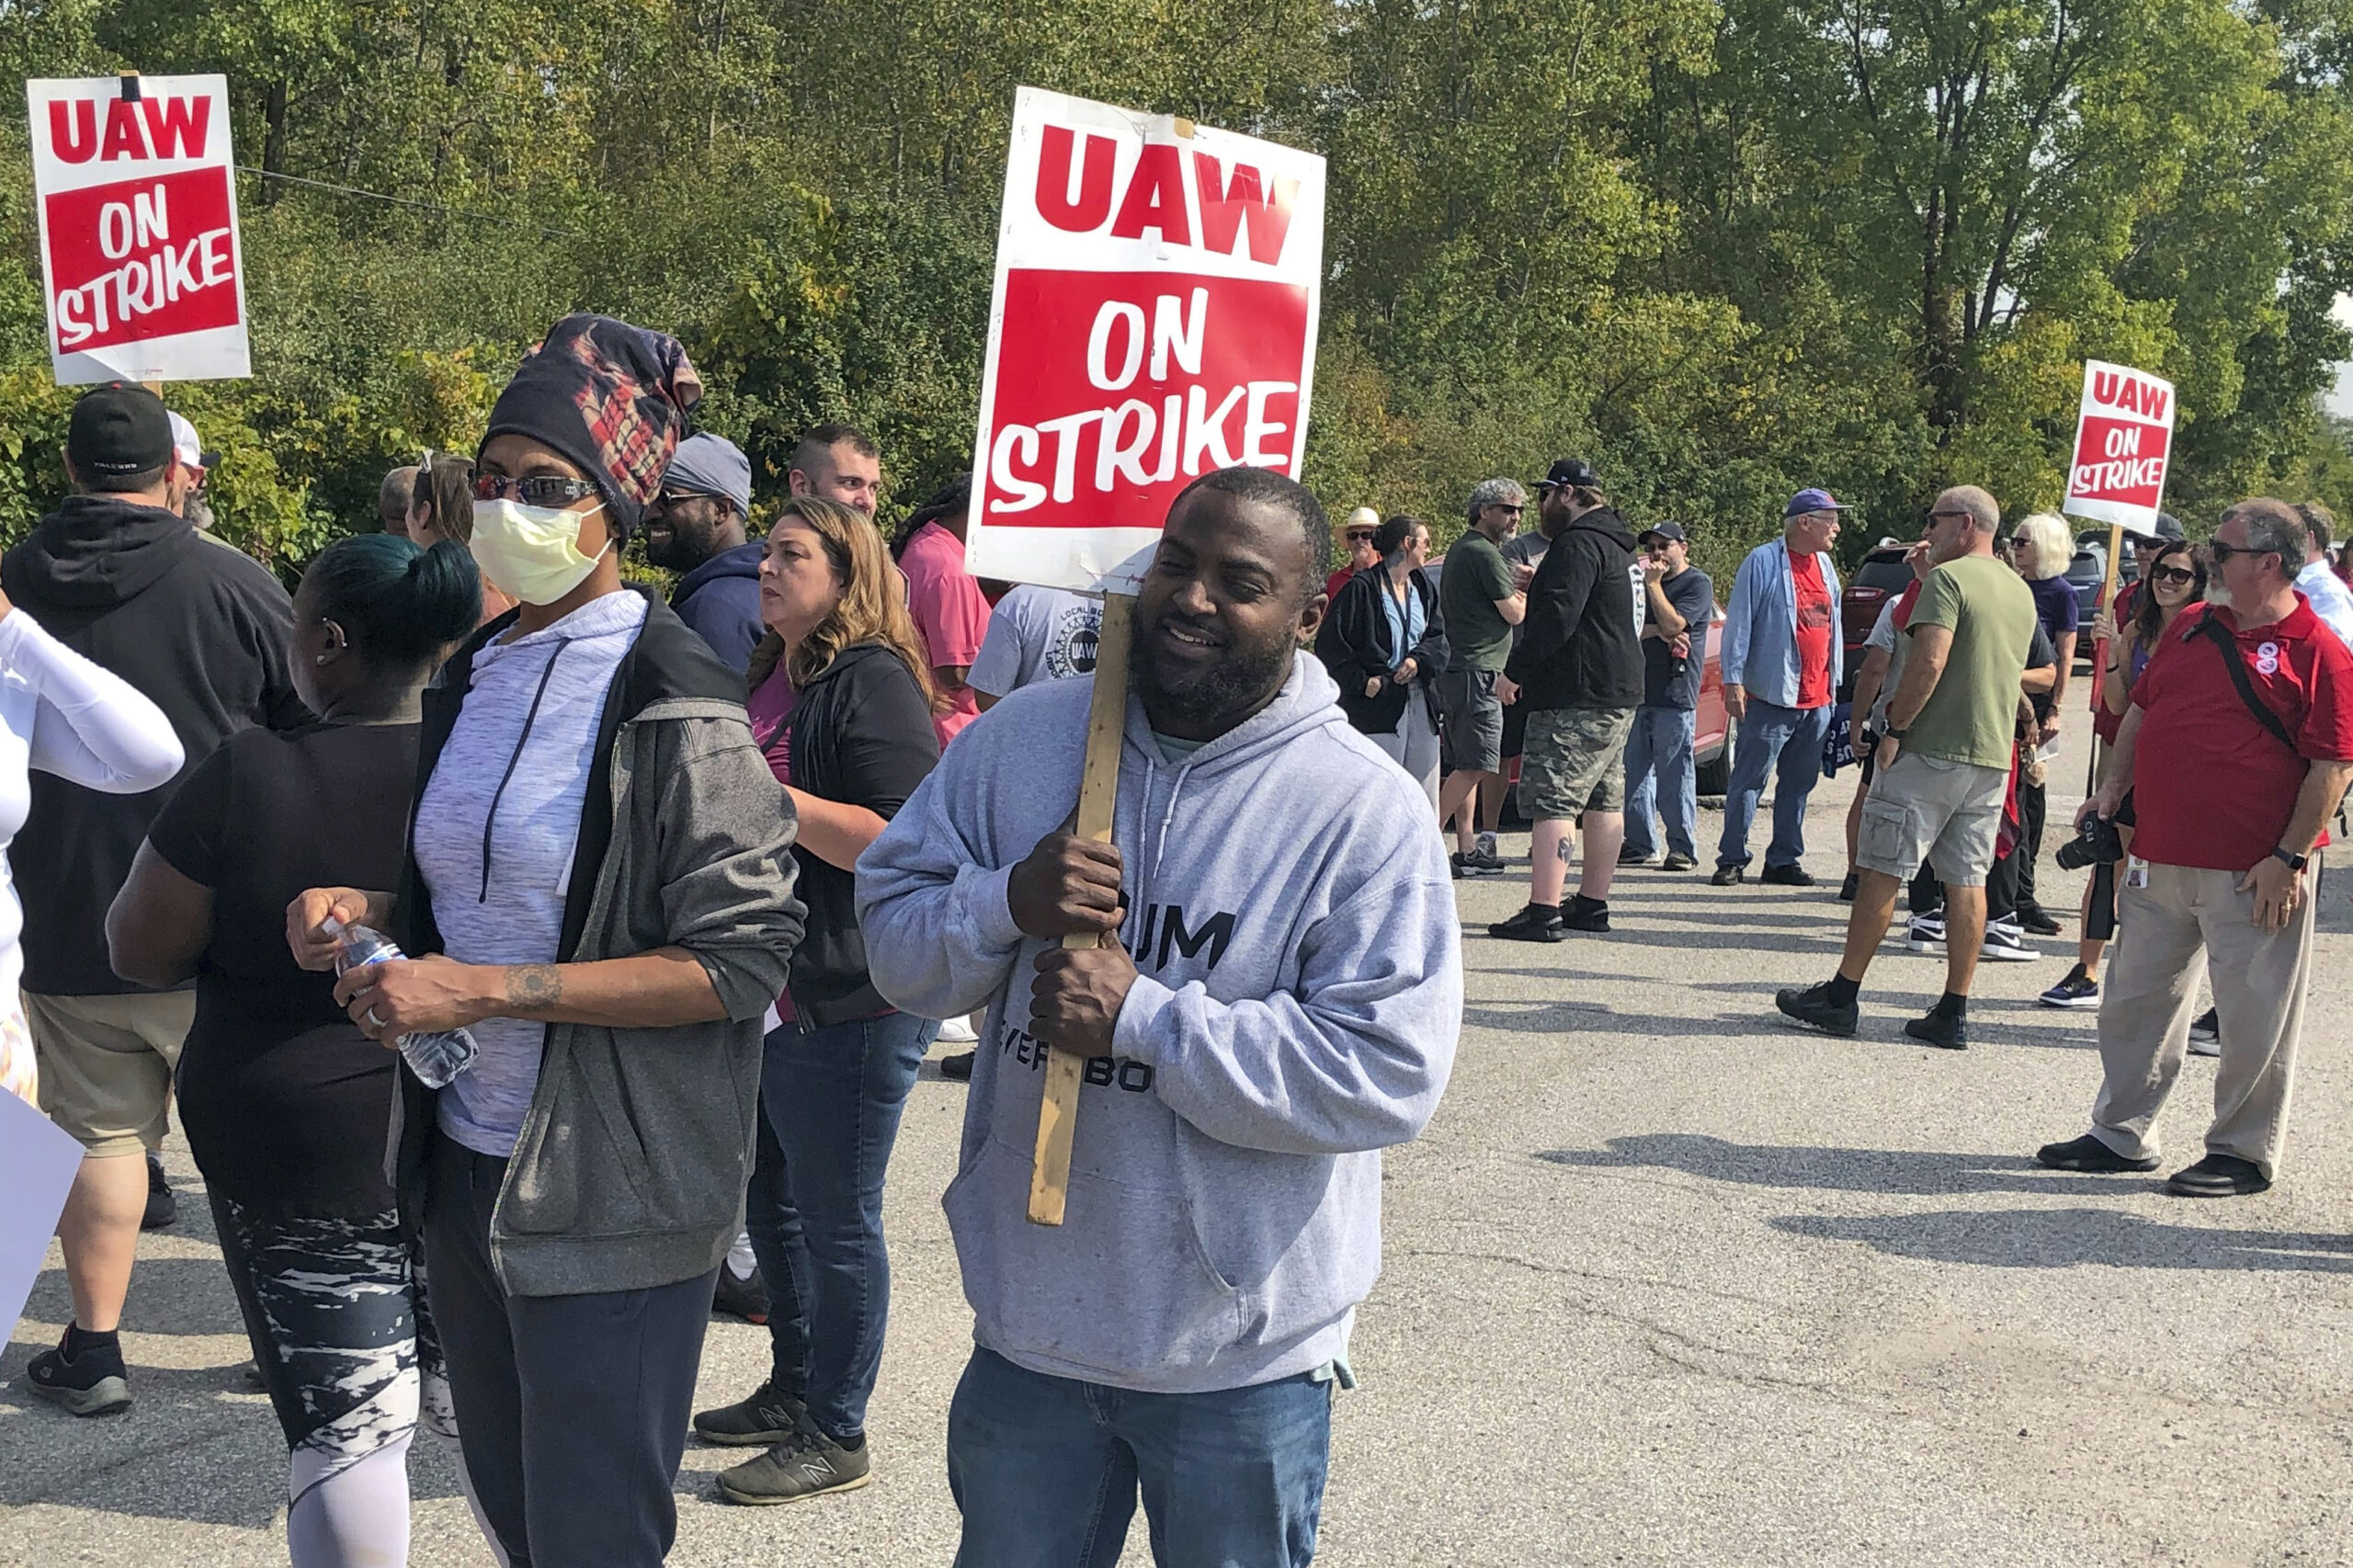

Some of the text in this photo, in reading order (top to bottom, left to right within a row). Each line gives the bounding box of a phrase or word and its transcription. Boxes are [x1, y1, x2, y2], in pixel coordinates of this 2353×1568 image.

[48, 95, 212, 165] UAW
[99, 183, 169, 259] ON
[1035, 123, 1301, 266] UAW
[57, 227, 233, 346] STRIKE
[1086, 286, 1209, 392] ON
[2093, 369, 2168, 421] UAW
[990, 381, 1298, 513] STRIKE
[2073, 457, 2164, 494] STRIKE
[2105, 426, 2142, 458] ON
[1060, 607, 1089, 621] LOCAL
[1071, 642, 1099, 660] UAW
